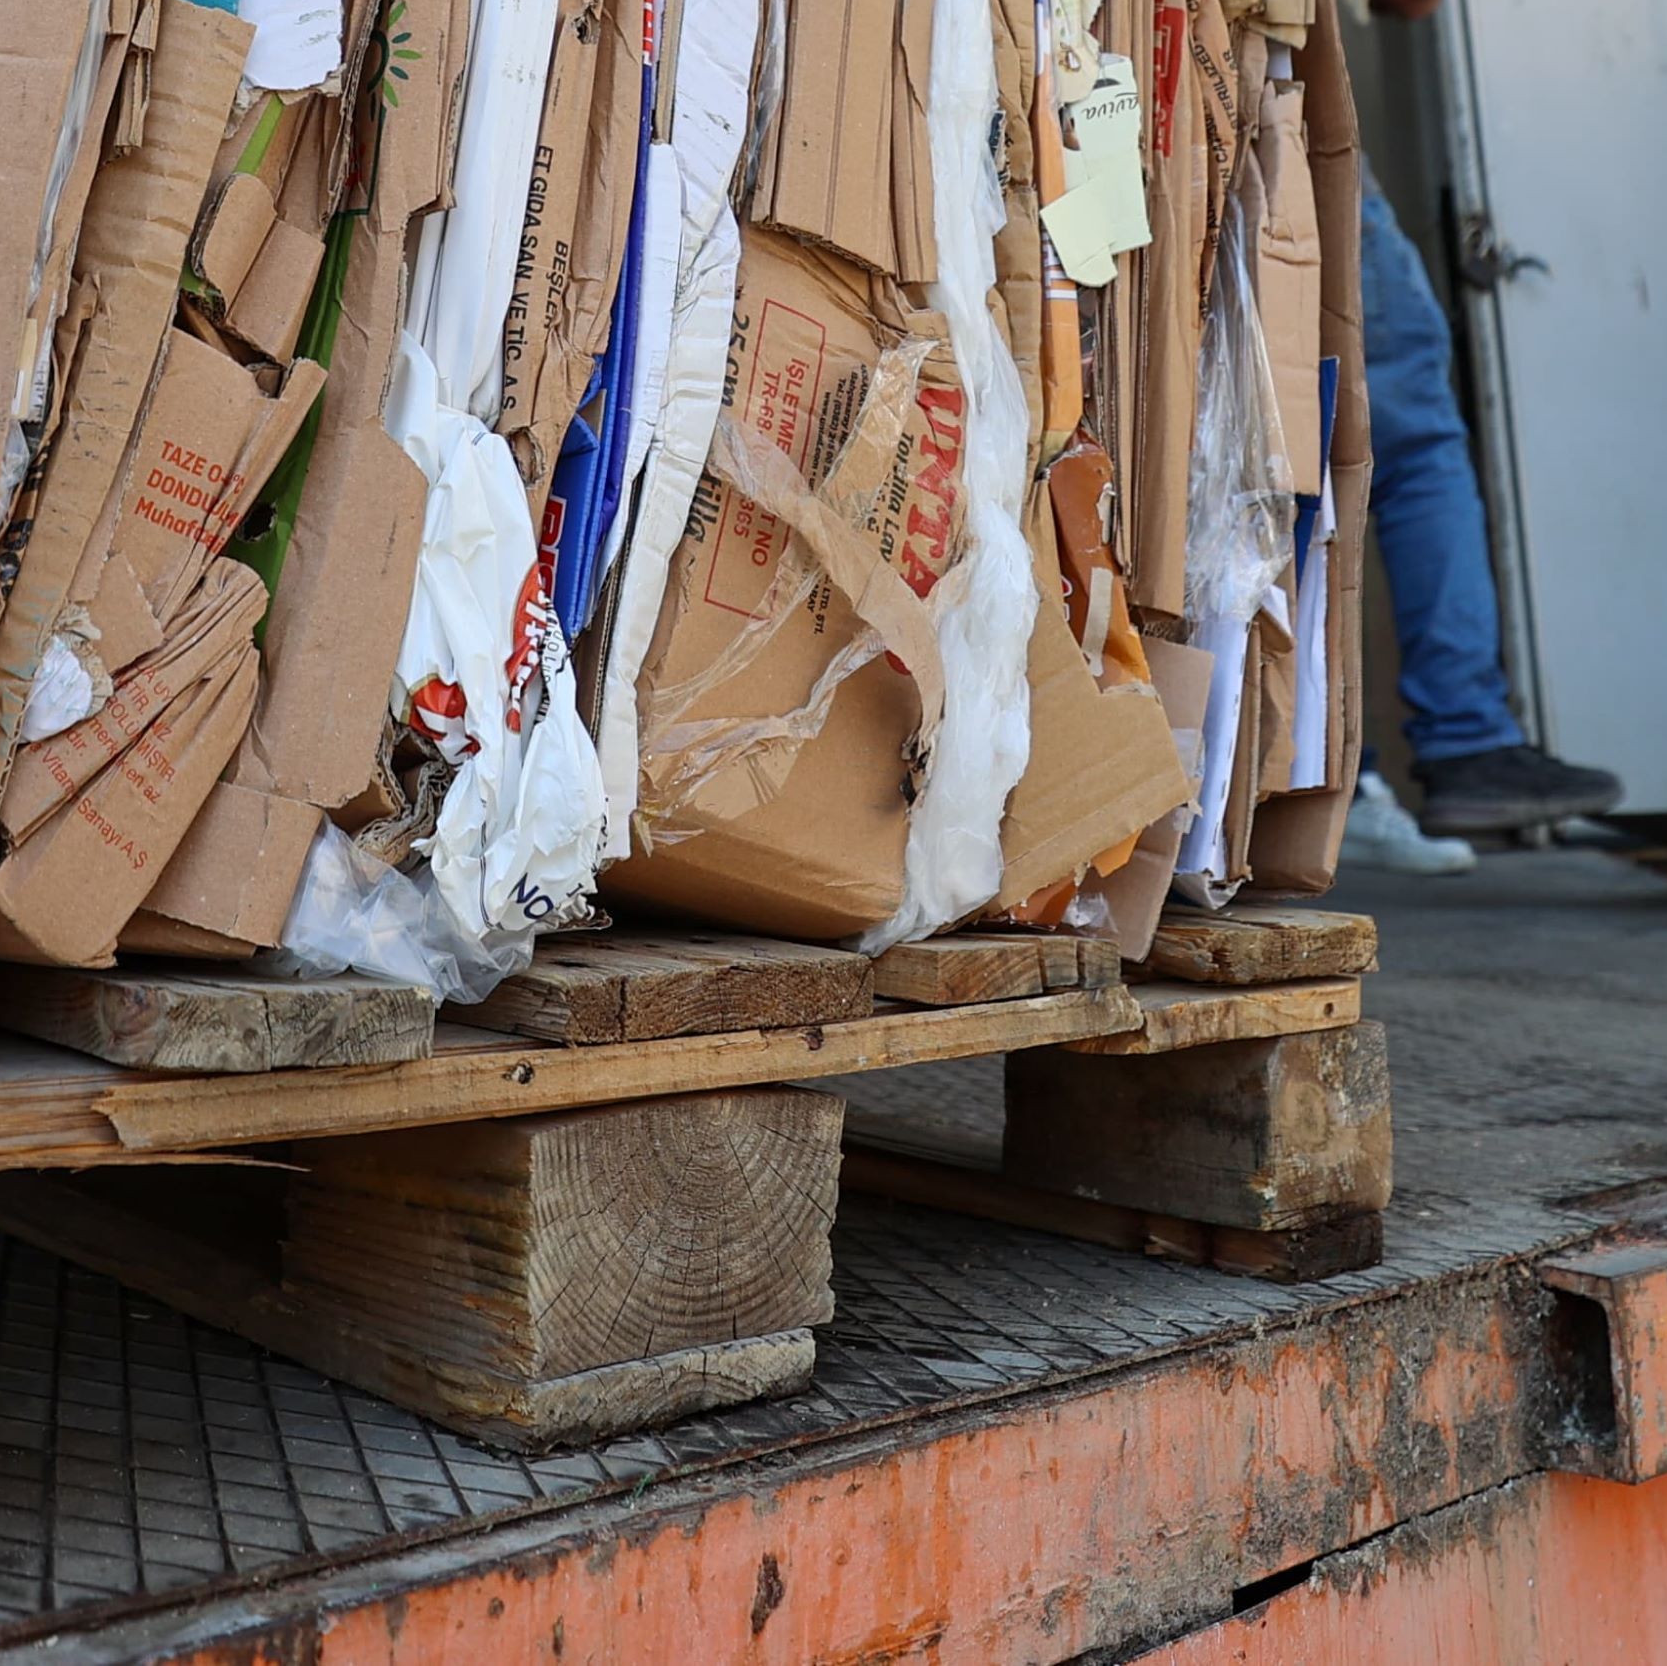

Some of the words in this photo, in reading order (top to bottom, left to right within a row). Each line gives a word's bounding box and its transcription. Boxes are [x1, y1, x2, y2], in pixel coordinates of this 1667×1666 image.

[535, 144, 554, 173] ET
[524, 175, 548, 229] GIDA
[507, 291, 532, 321] VE
[776, 357, 810, 456] İŞLETME
[160, 439, 208, 477] TAZE
[903, 387, 963, 600] UNTA
[751, 530, 774, 567] NO
[126, 767, 146, 785] en
[144, 785, 161, 804] az
[77, 797, 122, 847] Sanayi
